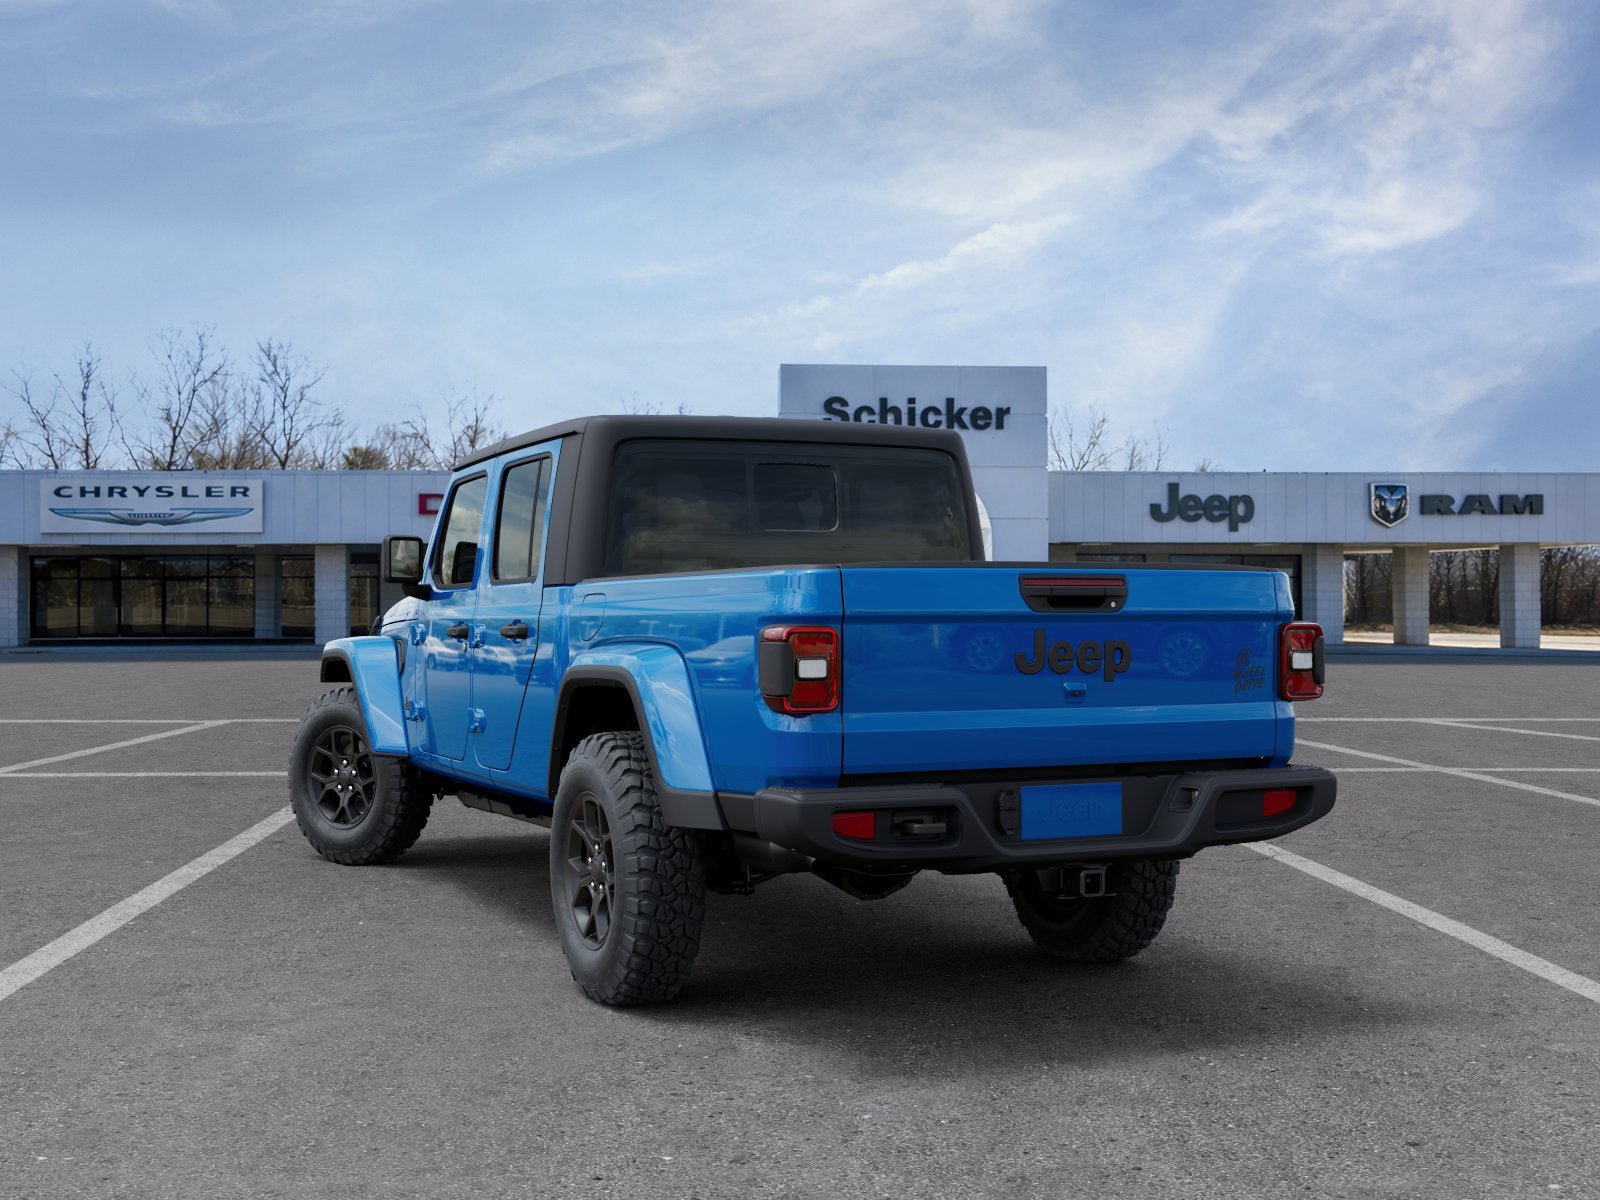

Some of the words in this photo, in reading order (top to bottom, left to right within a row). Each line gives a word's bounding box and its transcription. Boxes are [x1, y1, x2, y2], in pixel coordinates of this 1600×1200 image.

[823, 396, 1011, 430] Schicker
[53, 486, 250, 498] CHRYSLER
[1149, 482, 1255, 532] Jeep
[1420, 494, 1544, 515] RAM
[1014, 629, 1131, 682] Jeep
[1038, 793, 1104, 825] Jeep
